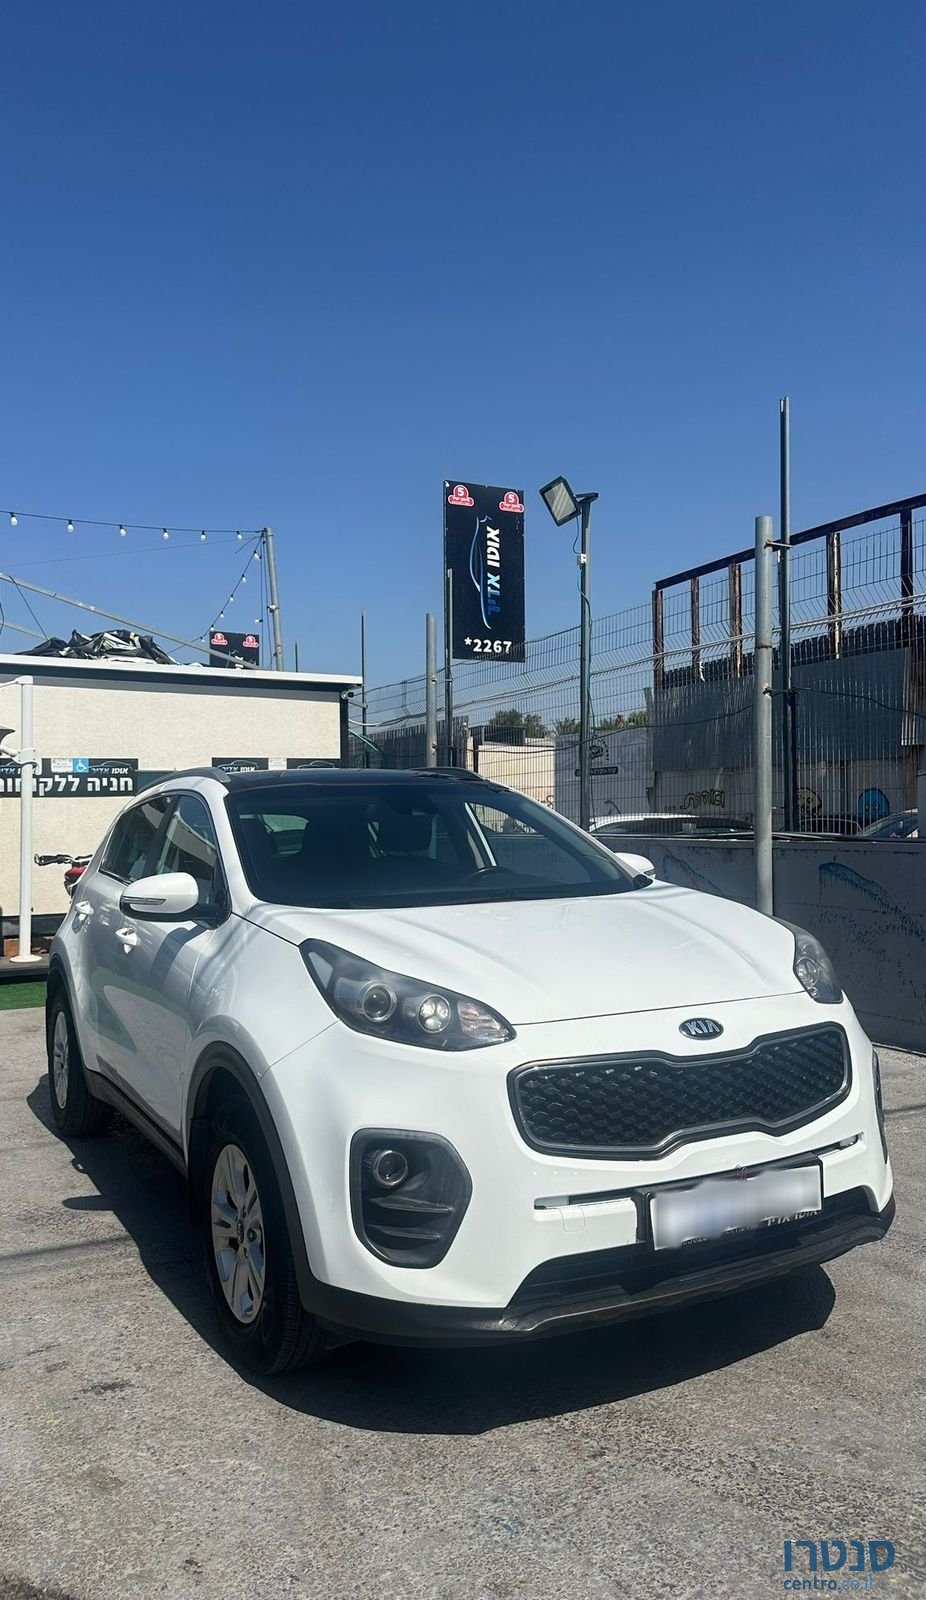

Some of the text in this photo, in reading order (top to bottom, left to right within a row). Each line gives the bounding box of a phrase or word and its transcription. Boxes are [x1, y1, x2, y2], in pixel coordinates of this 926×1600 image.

[457, 487, 465, 497] 5
[508, 494, 515, 503] 5
[487, 526, 500, 615] אוטו אדיר
[87, 777, 133, 792] חניה
[685, 1019, 720, 1035] KIA
